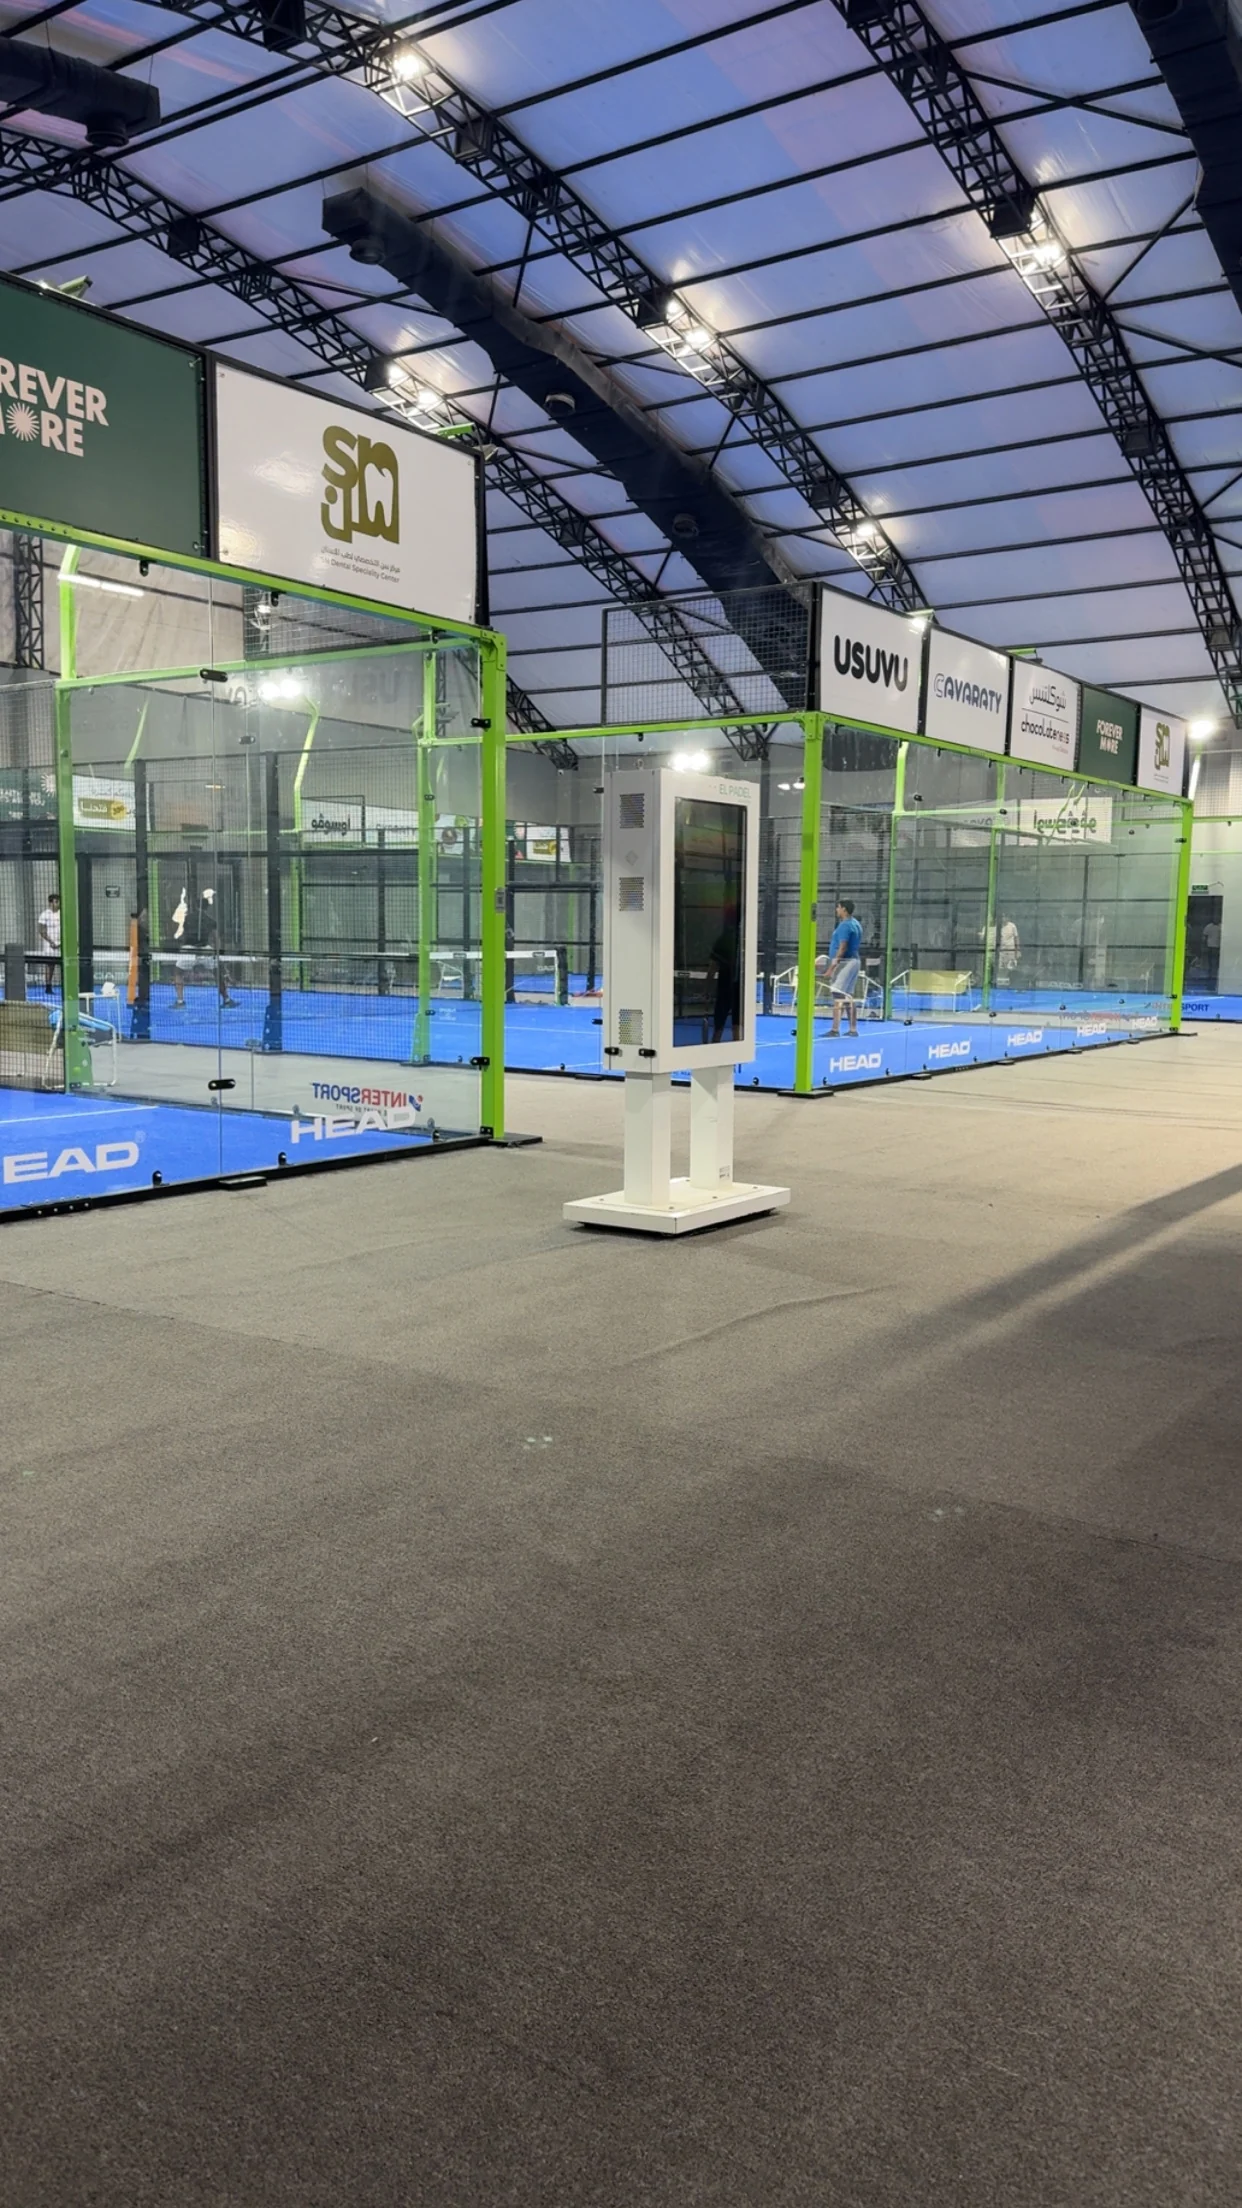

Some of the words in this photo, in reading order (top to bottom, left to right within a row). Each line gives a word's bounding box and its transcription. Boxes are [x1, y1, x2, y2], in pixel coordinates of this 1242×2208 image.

[0, 401, 84, 457] ORE
[331, 558, 351, 570] Dental
[381, 572, 399, 583] Center
[834, 634, 908, 692] USUVU
[934, 673, 1002, 714] CAVARATY
[1096, 719, 1123, 741] FOREVER
[1077, 1023, 1107, 1038] HEAD
[1131, 1016, 1158, 1030] HEAD
[928, 1040, 971, 1060] HEAD
[1007, 1030, 1043, 1048] HEAD
[830, 1052, 882, 1073] HEAD
[291, 1105, 416, 1144] HEAD
